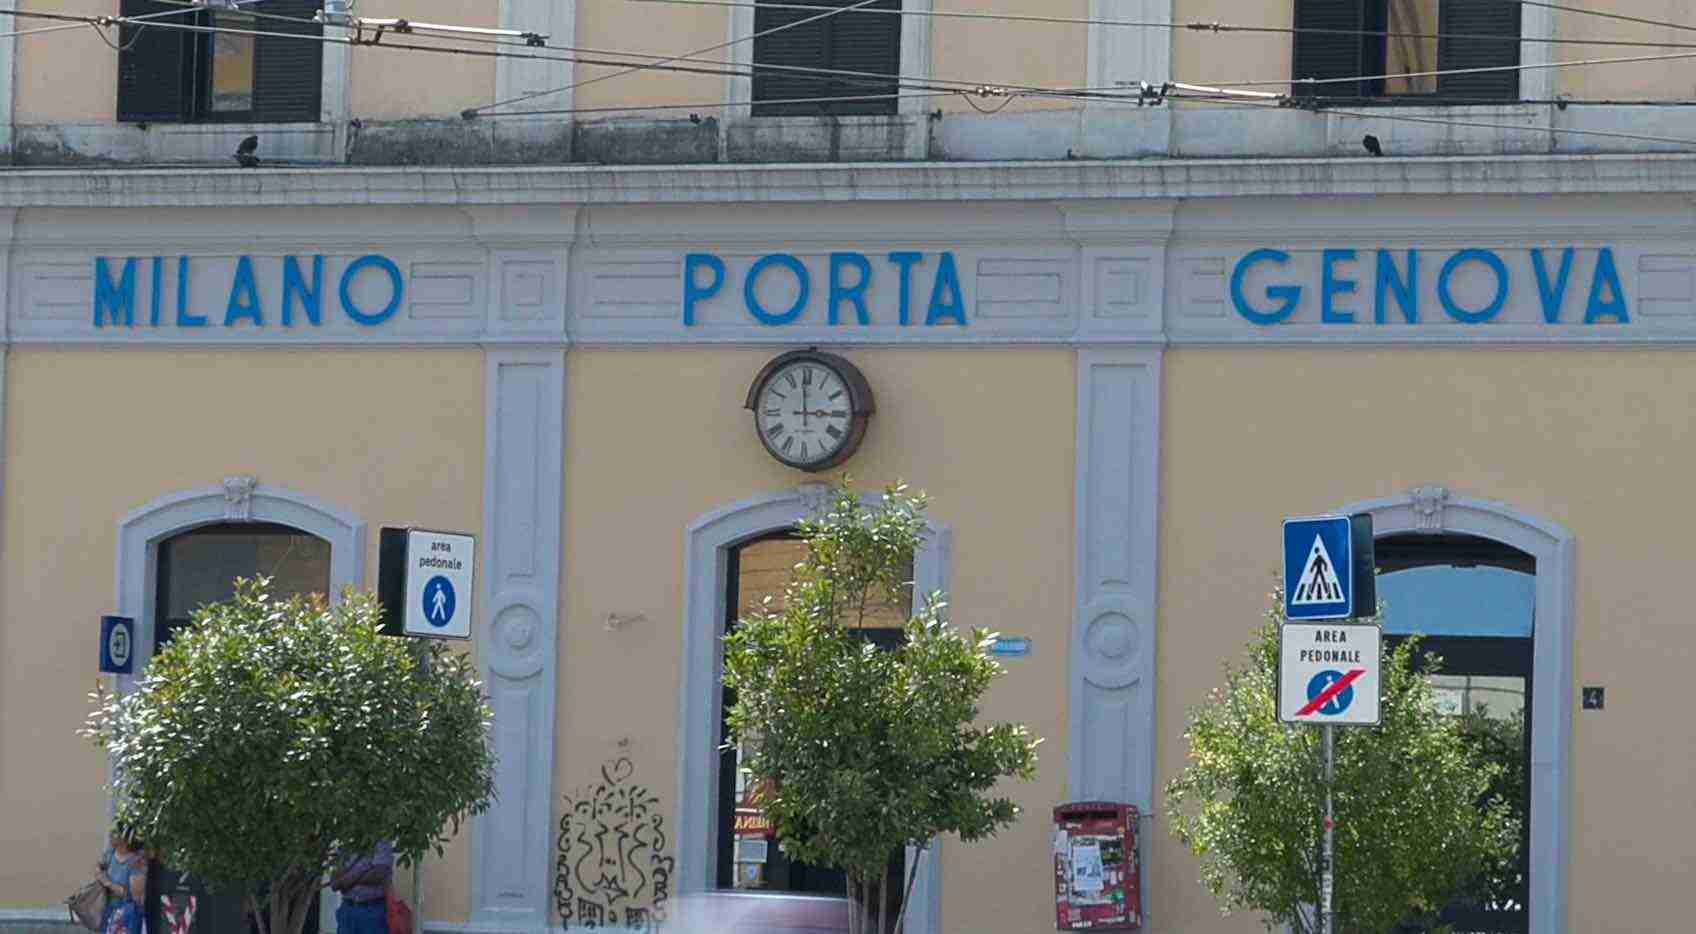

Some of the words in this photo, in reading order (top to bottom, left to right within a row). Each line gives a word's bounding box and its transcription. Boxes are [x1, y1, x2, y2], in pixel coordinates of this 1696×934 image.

[93, 255, 404, 327] MILANO
[683, 251, 967, 326] PORTA
[1230, 247, 1630, 325] GENOVA
[431, 542, 452, 553] area
[419, 557, 463, 570] pedonale
[1315, 630, 1346, 642] AREA
[1300, 650, 1361, 662] PEDONALE
